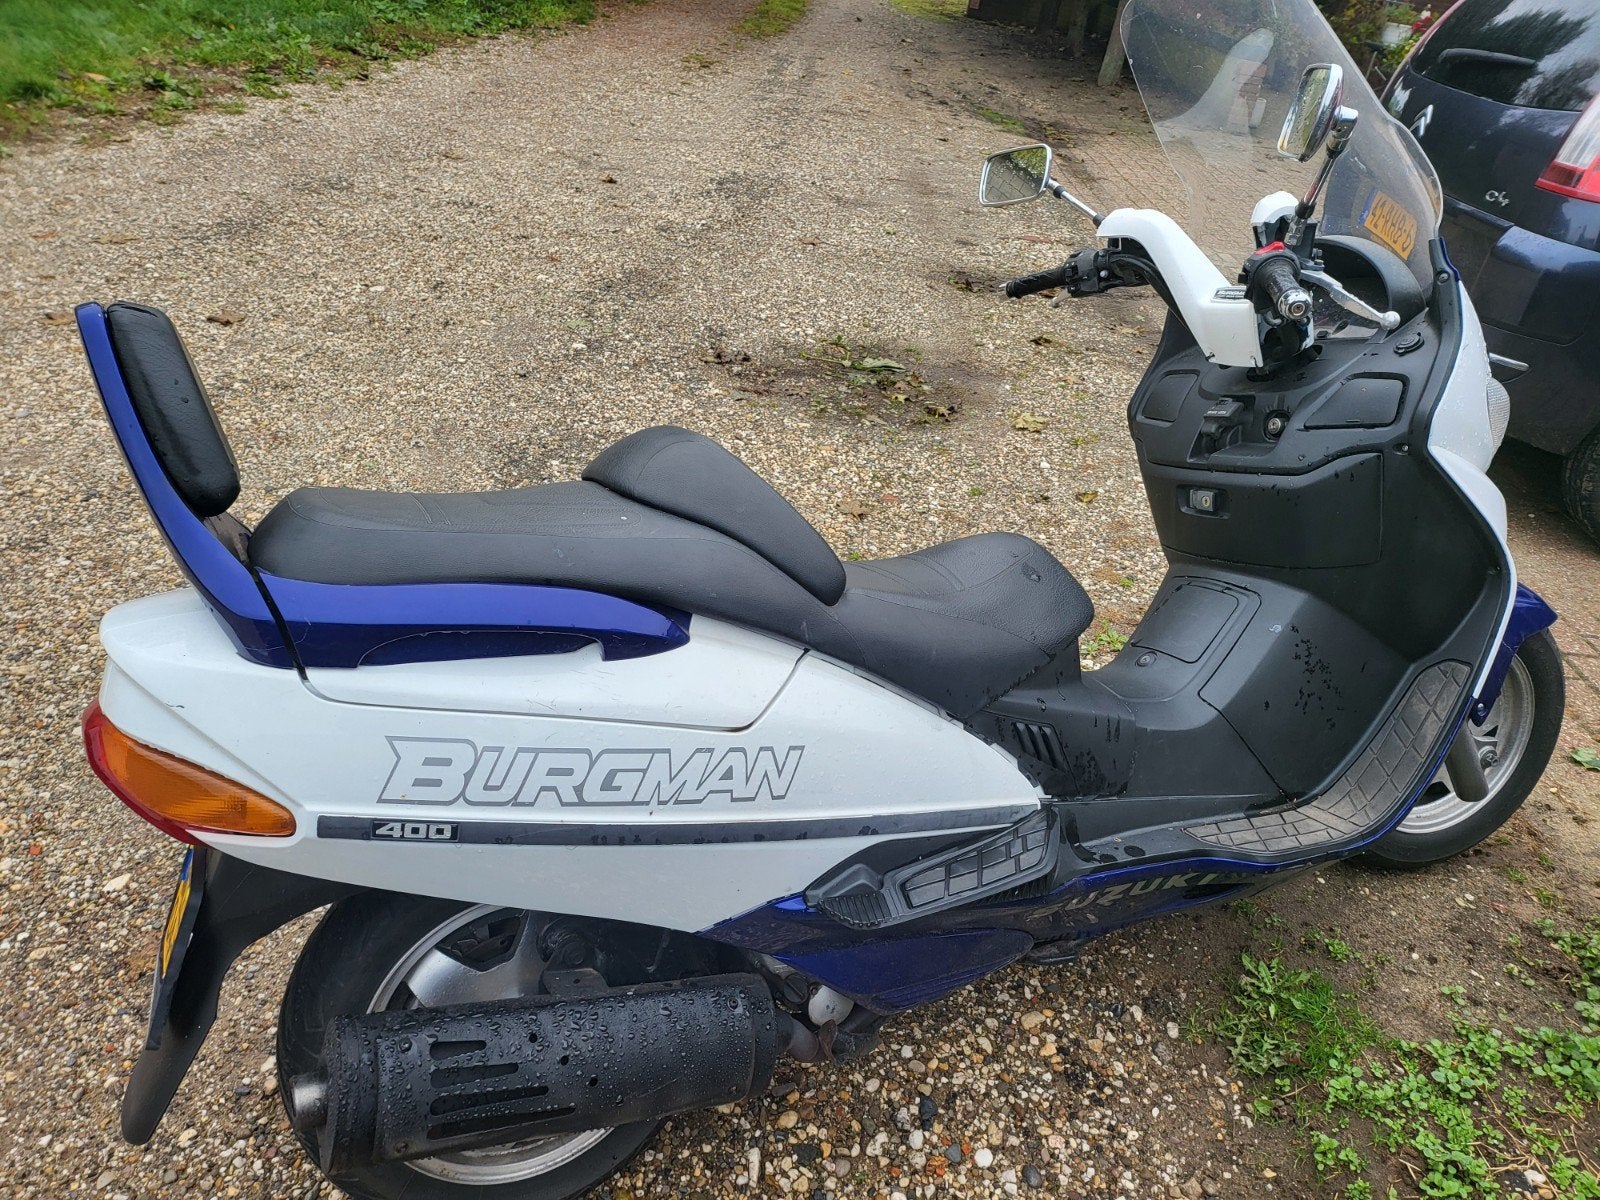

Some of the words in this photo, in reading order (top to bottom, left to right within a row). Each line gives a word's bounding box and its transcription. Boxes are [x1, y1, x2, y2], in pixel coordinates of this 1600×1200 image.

[1485, 190, 1510, 207] C4
[376, 735, 805, 807] BURGMAN
[375, 823, 452, 839] 400
[1027, 871, 1220, 919] SUZUKI
